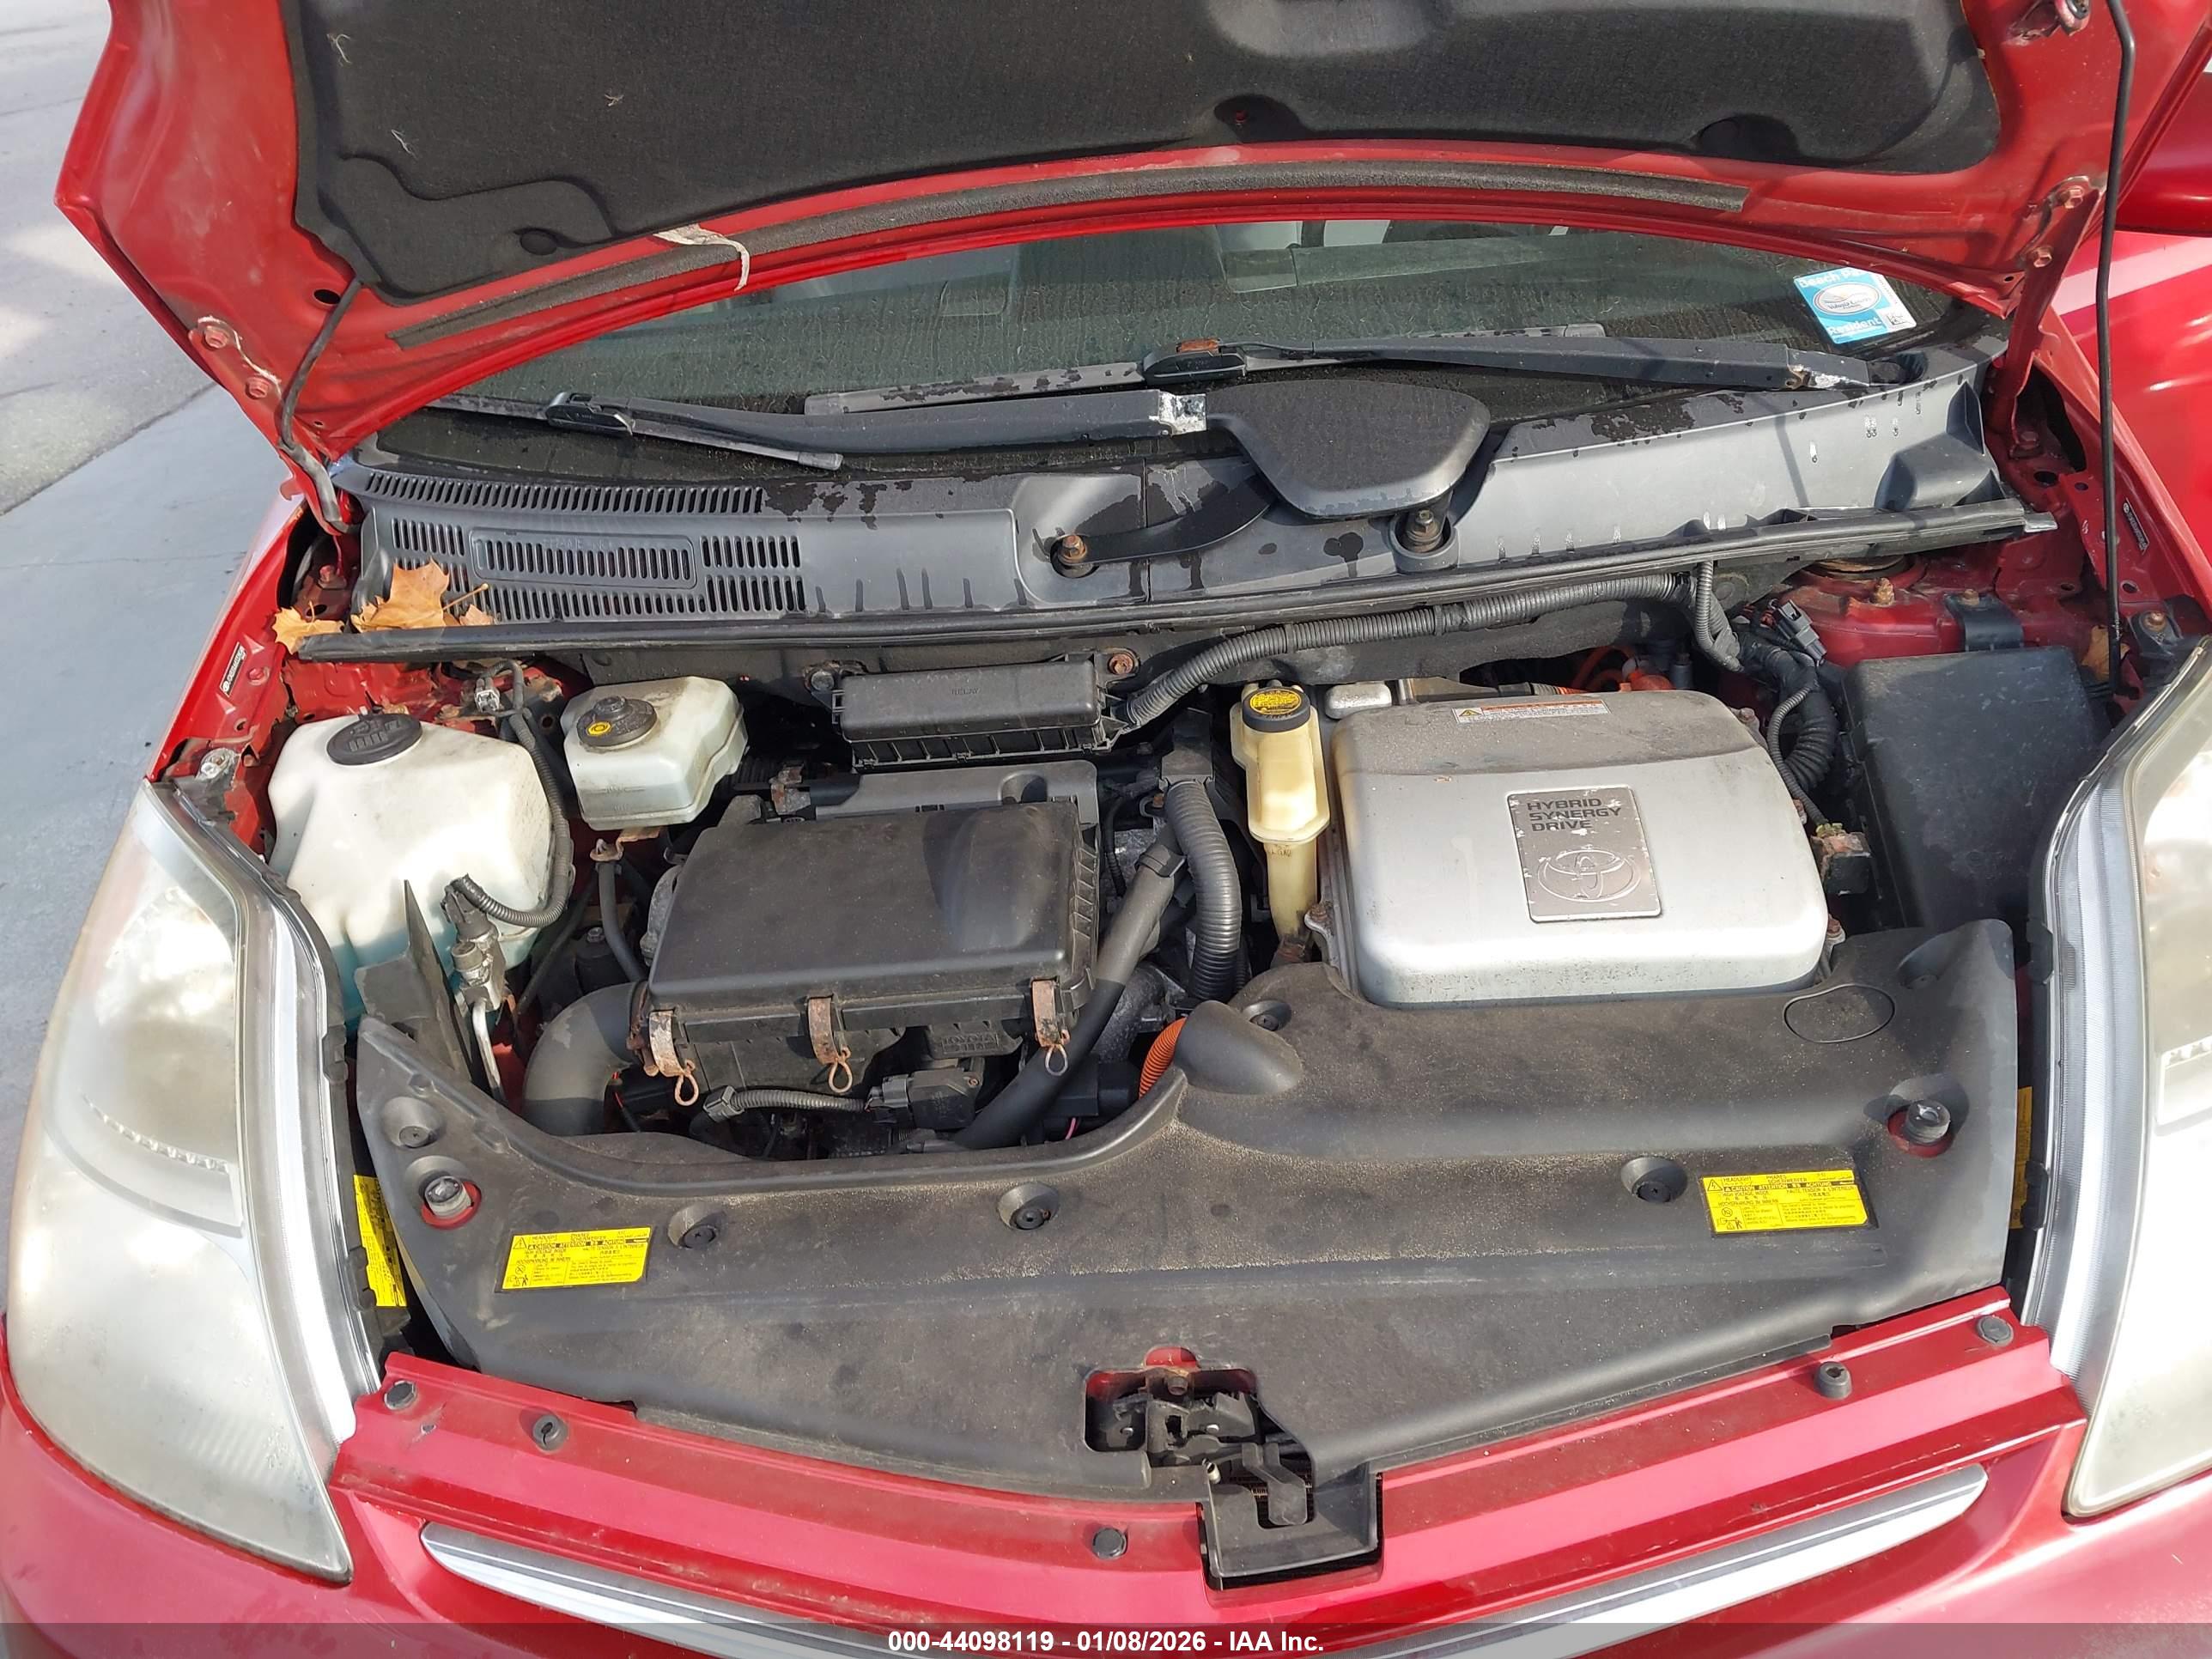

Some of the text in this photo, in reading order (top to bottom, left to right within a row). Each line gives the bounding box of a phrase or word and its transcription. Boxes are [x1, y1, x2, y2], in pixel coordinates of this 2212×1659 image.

[1826, 317, 1882, 336] Resident
[1527, 798, 1602, 811] HYBRID
[1528, 807, 1621, 821] SYNERGY
[1531, 820, 1593, 832] DRIVE
